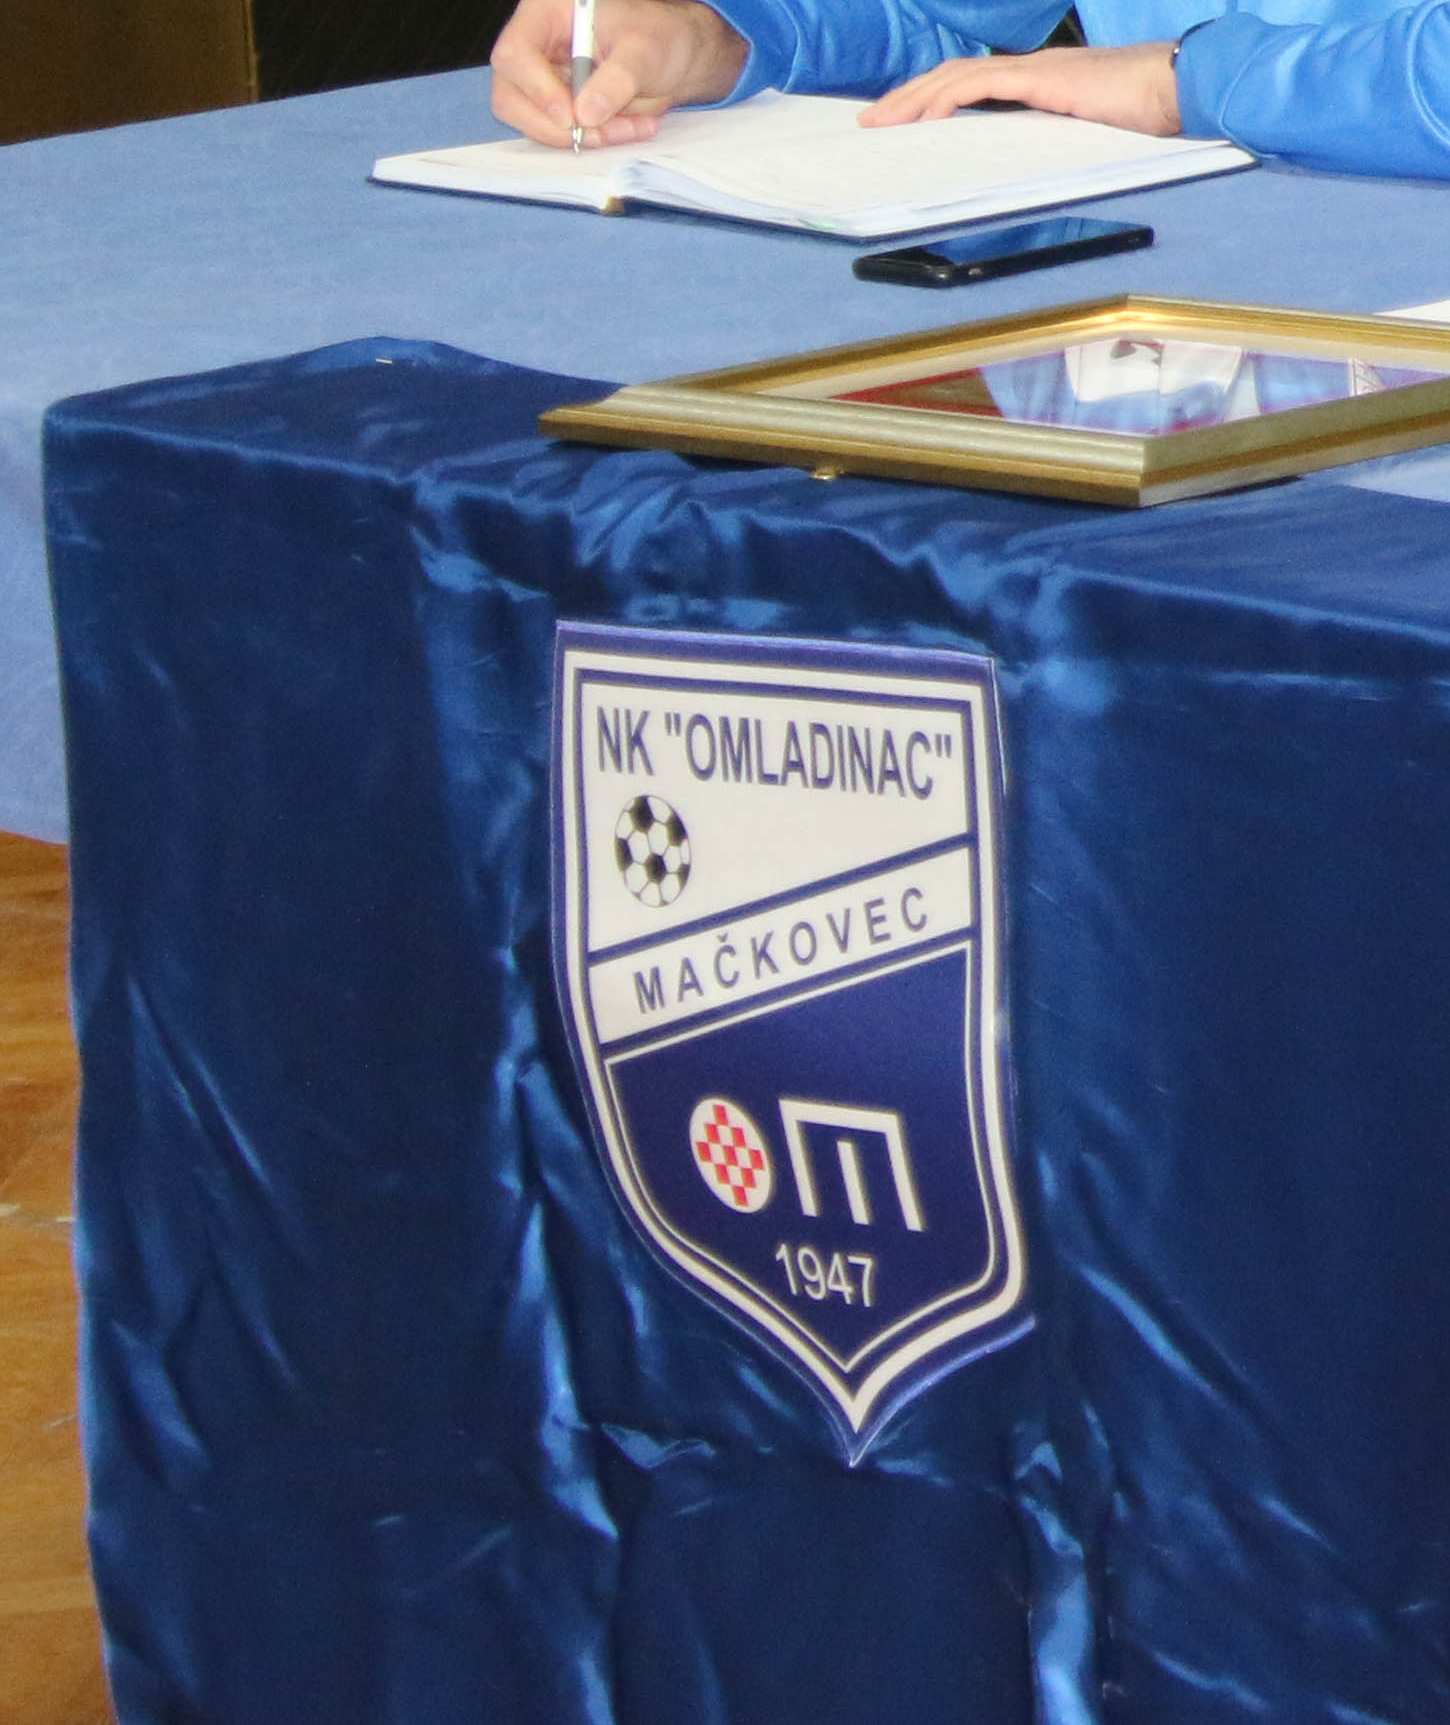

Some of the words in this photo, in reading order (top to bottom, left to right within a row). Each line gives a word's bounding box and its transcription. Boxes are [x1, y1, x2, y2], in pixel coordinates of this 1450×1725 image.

[596, 705, 655, 777] NK
[664, 711, 953, 801] "OMLADINAC"
[633, 886, 929, 1016] MAČKOVEC
[775, 1242, 873, 1309] 1947
